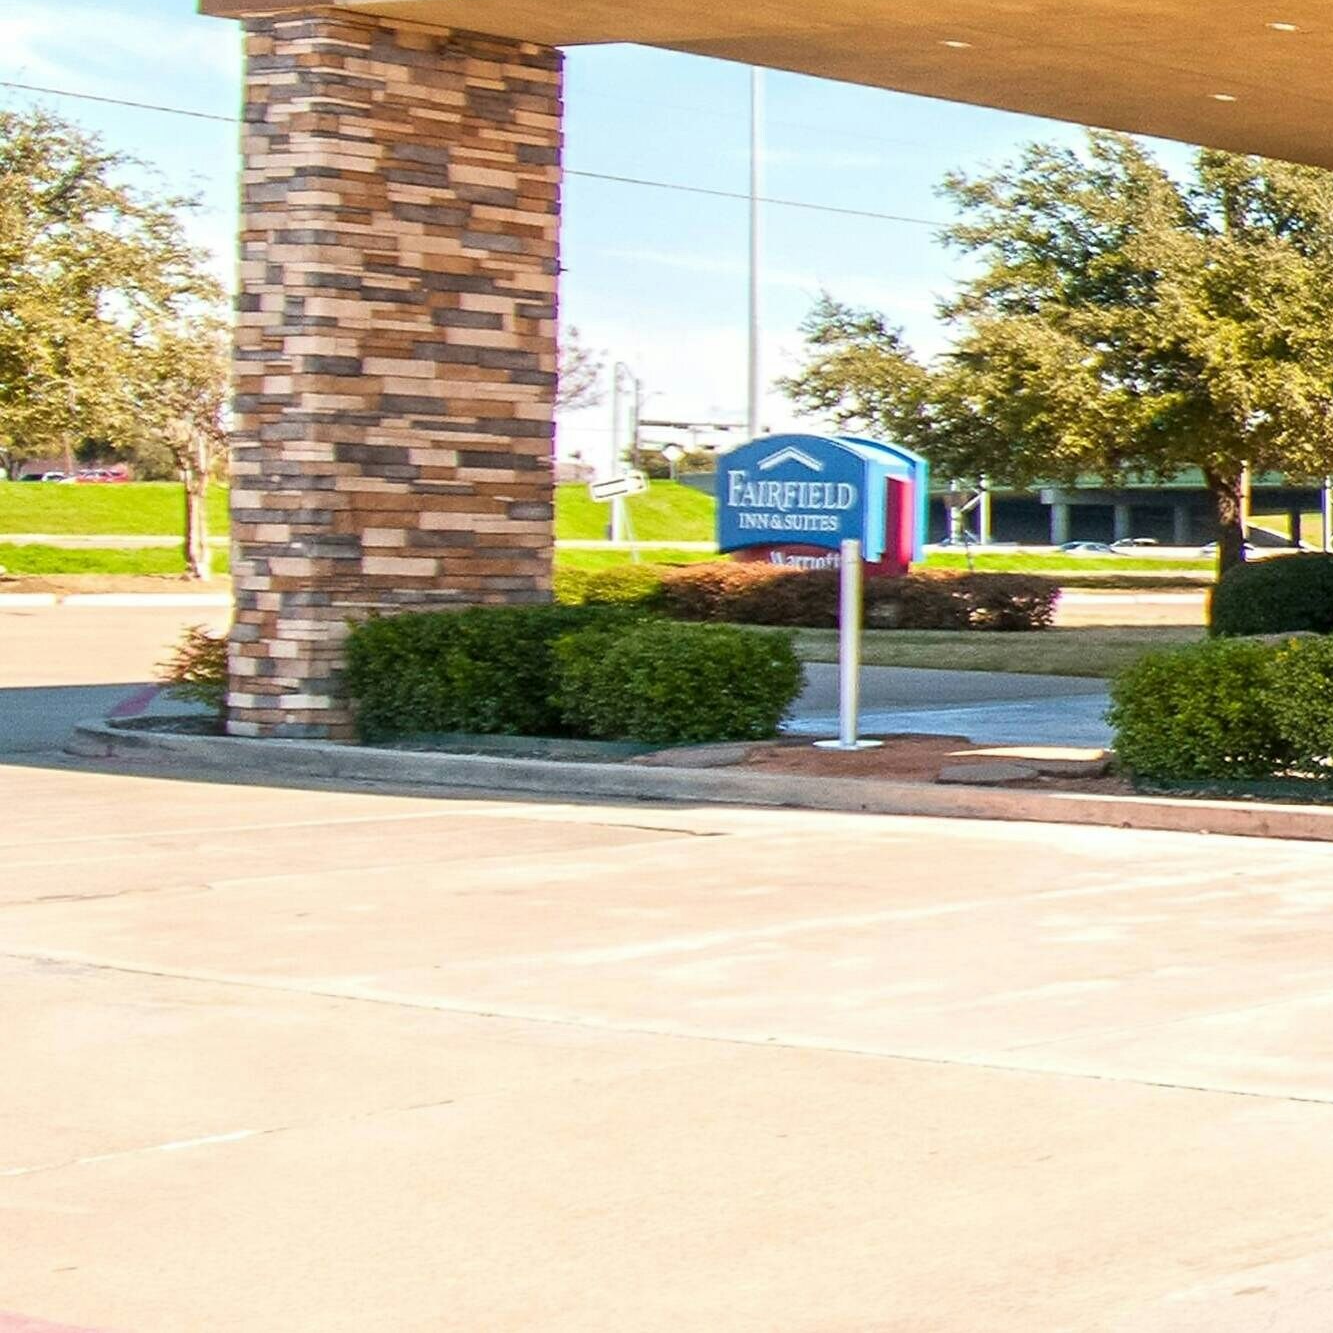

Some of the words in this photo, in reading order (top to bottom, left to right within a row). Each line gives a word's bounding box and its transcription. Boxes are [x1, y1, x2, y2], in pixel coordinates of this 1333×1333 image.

[727, 470, 857, 512] FAIRFIELD
[739, 513, 769, 530] INN
[769, 514, 783, 530] &
[784, 514, 838, 532] SUITES
